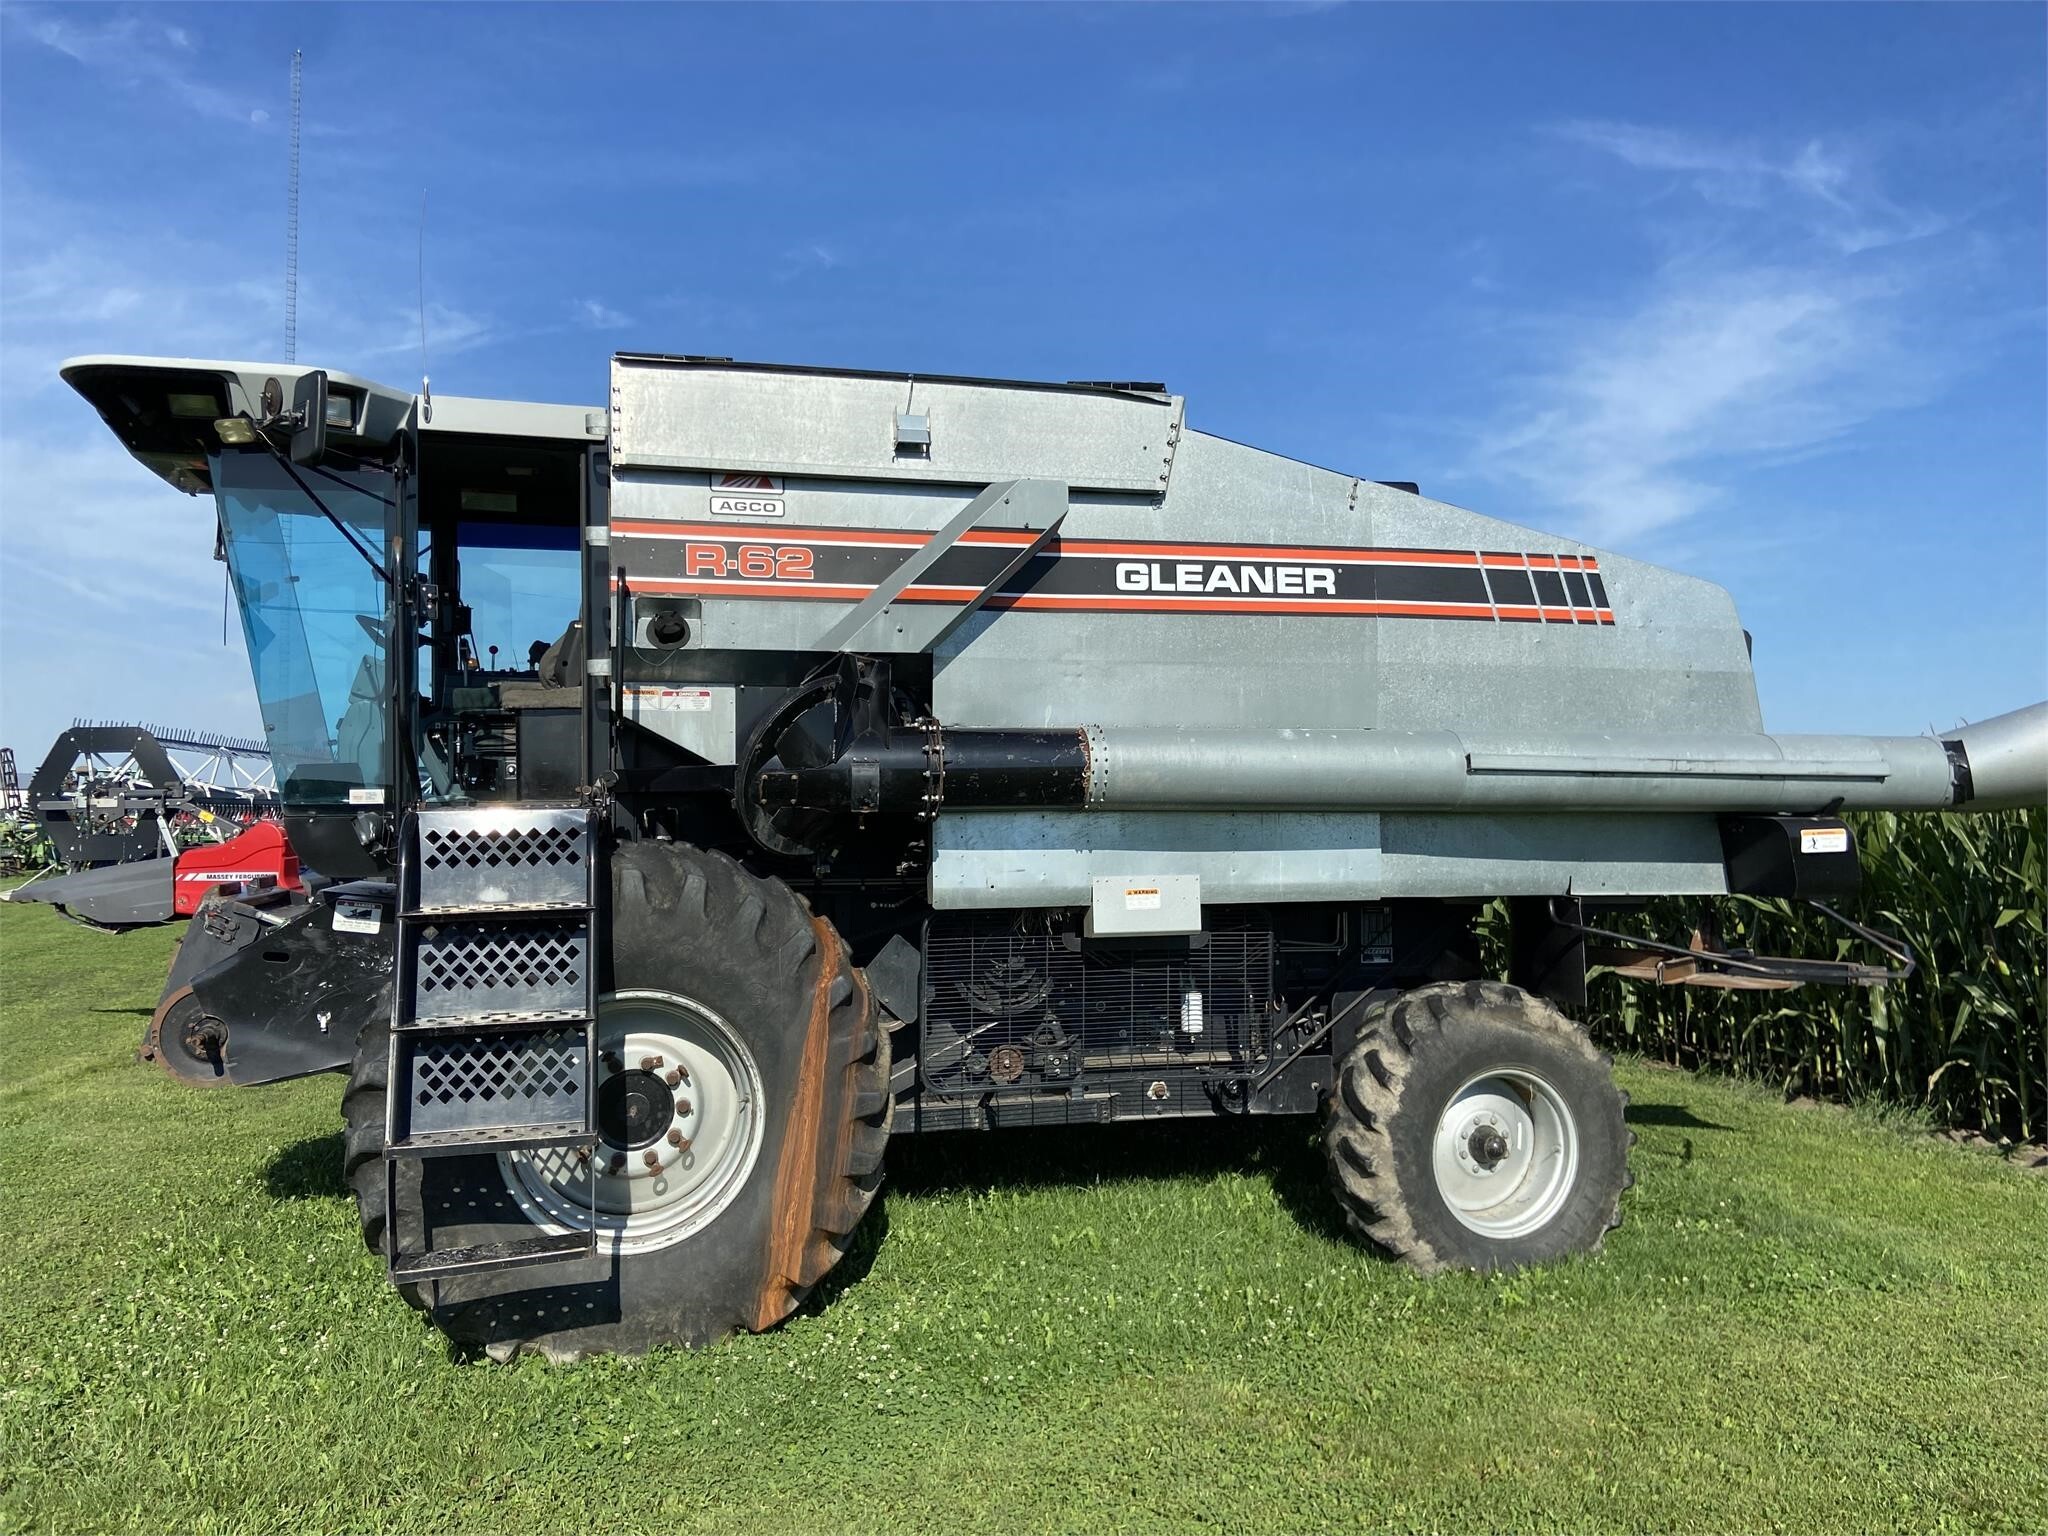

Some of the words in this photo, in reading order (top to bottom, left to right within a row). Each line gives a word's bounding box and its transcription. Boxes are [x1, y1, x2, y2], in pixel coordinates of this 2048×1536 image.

[719, 501, 777, 513] AGCO
[685, 543, 815, 580] R-62
[1115, 562, 1337, 595] GLEANER
